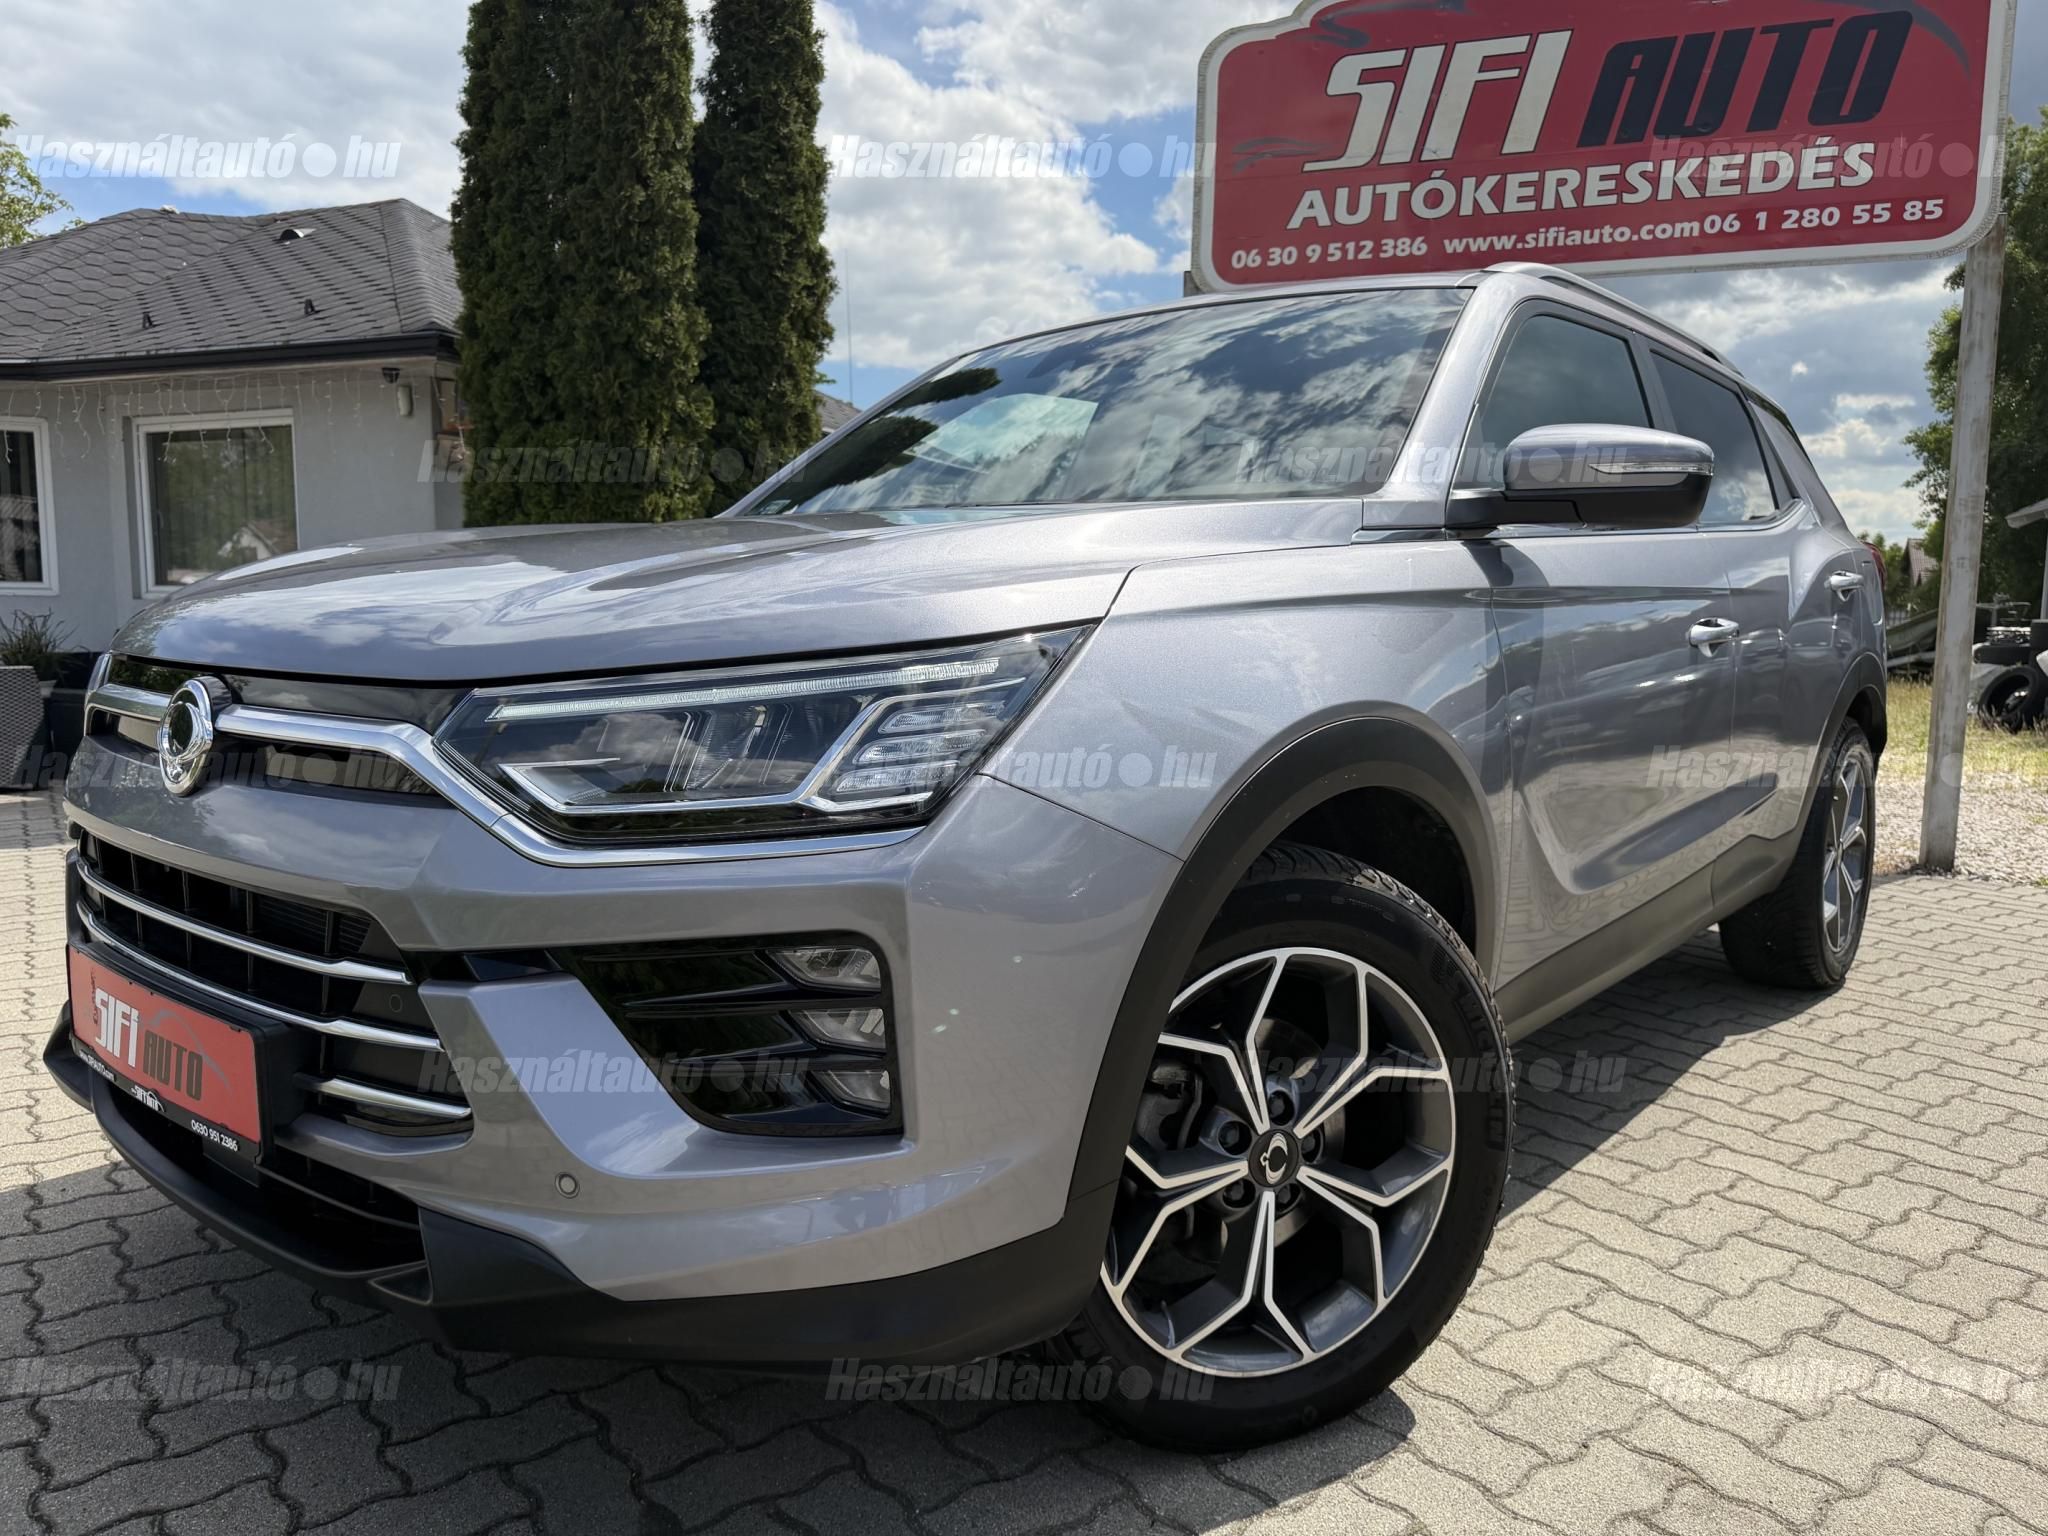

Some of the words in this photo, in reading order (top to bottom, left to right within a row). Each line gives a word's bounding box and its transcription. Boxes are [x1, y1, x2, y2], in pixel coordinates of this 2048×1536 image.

[1302, 29, 1573, 172] SIFI
[1576, 10, 1914, 148] AUTO
[1286, 136, 1876, 230] AUTÓKERESKEDÉS
[1443, 220, 1699, 253] www.sifiauto.com
[1703, 213, 1741, 234] 06
[1755, 211, 1768, 231] 1
[1781, 207, 1841, 229] 280
[1852, 203, 1892, 225] 55
[1903, 199, 1944, 220] 85
[1231, 248, 1262, 269] 06
[1266, 246, 1298, 267] 30
[1379, 236, 1428, 258] 386
[143, 1030, 203, 1101] AUTO
